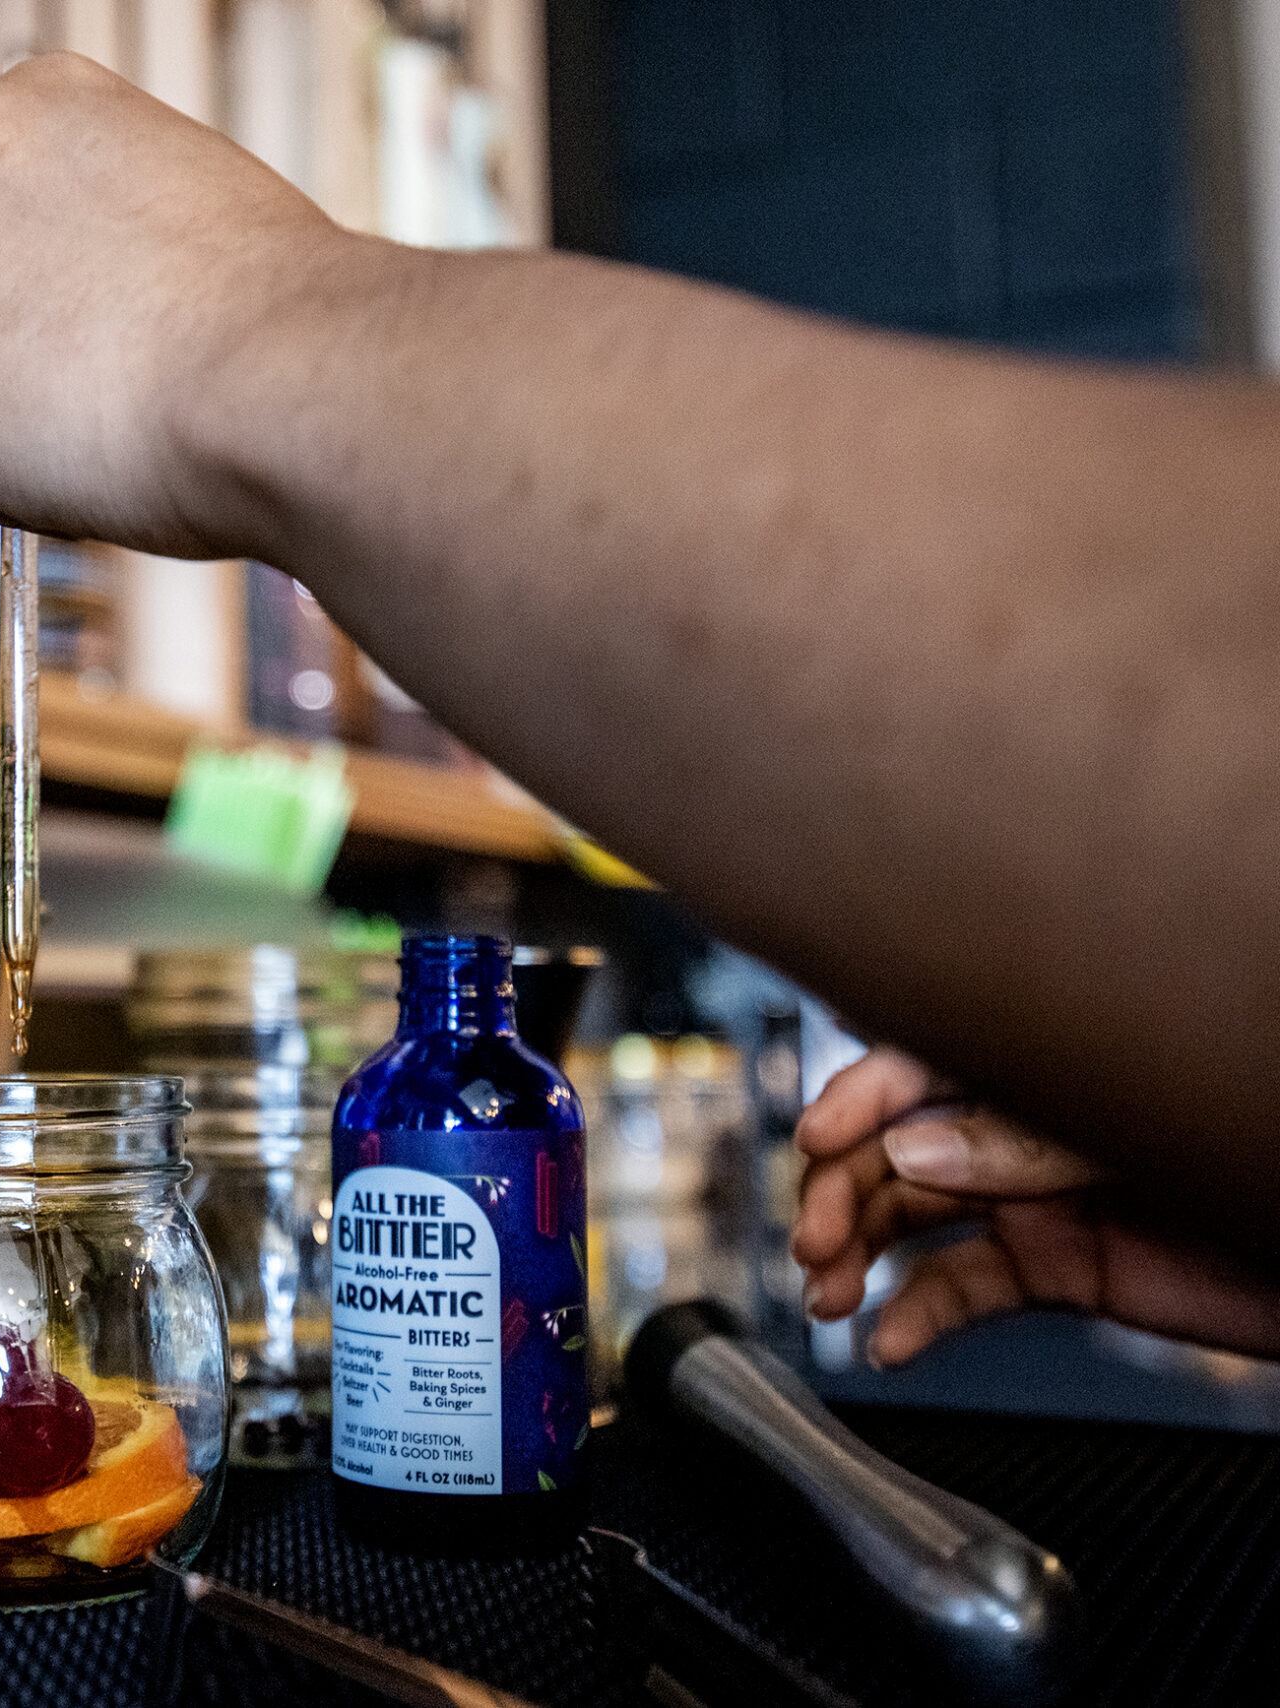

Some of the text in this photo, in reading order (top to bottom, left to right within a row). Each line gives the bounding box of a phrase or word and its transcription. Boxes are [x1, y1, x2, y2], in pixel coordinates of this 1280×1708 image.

[352, 1191, 445, 1217] ALL THE
[339, 1215, 476, 1260] BITTER
[355, 1262, 439, 1282] Alcohol-Free
[336, 1281, 483, 1318] AROMATIC
[408, 1329, 470, 1347] BITTERS
[412, 1366, 483, 1381] Bitter Roots,
[409, 1380, 487, 1396] Baking Spices
[423, 1396, 473, 1411] & Ginger
[360, 1425, 398, 1442] SUPPORT
[402, 1431, 464, 1447] DIGESTION,
[358, 1440, 387, 1455] HEALTH
[390, 1445, 397, 1456] &
[401, 1446, 440, 1460] GOOD
[443, 1449, 473, 1461] TIMES
[405, 1470, 495, 1485] 4 FL OZ (118mL)
